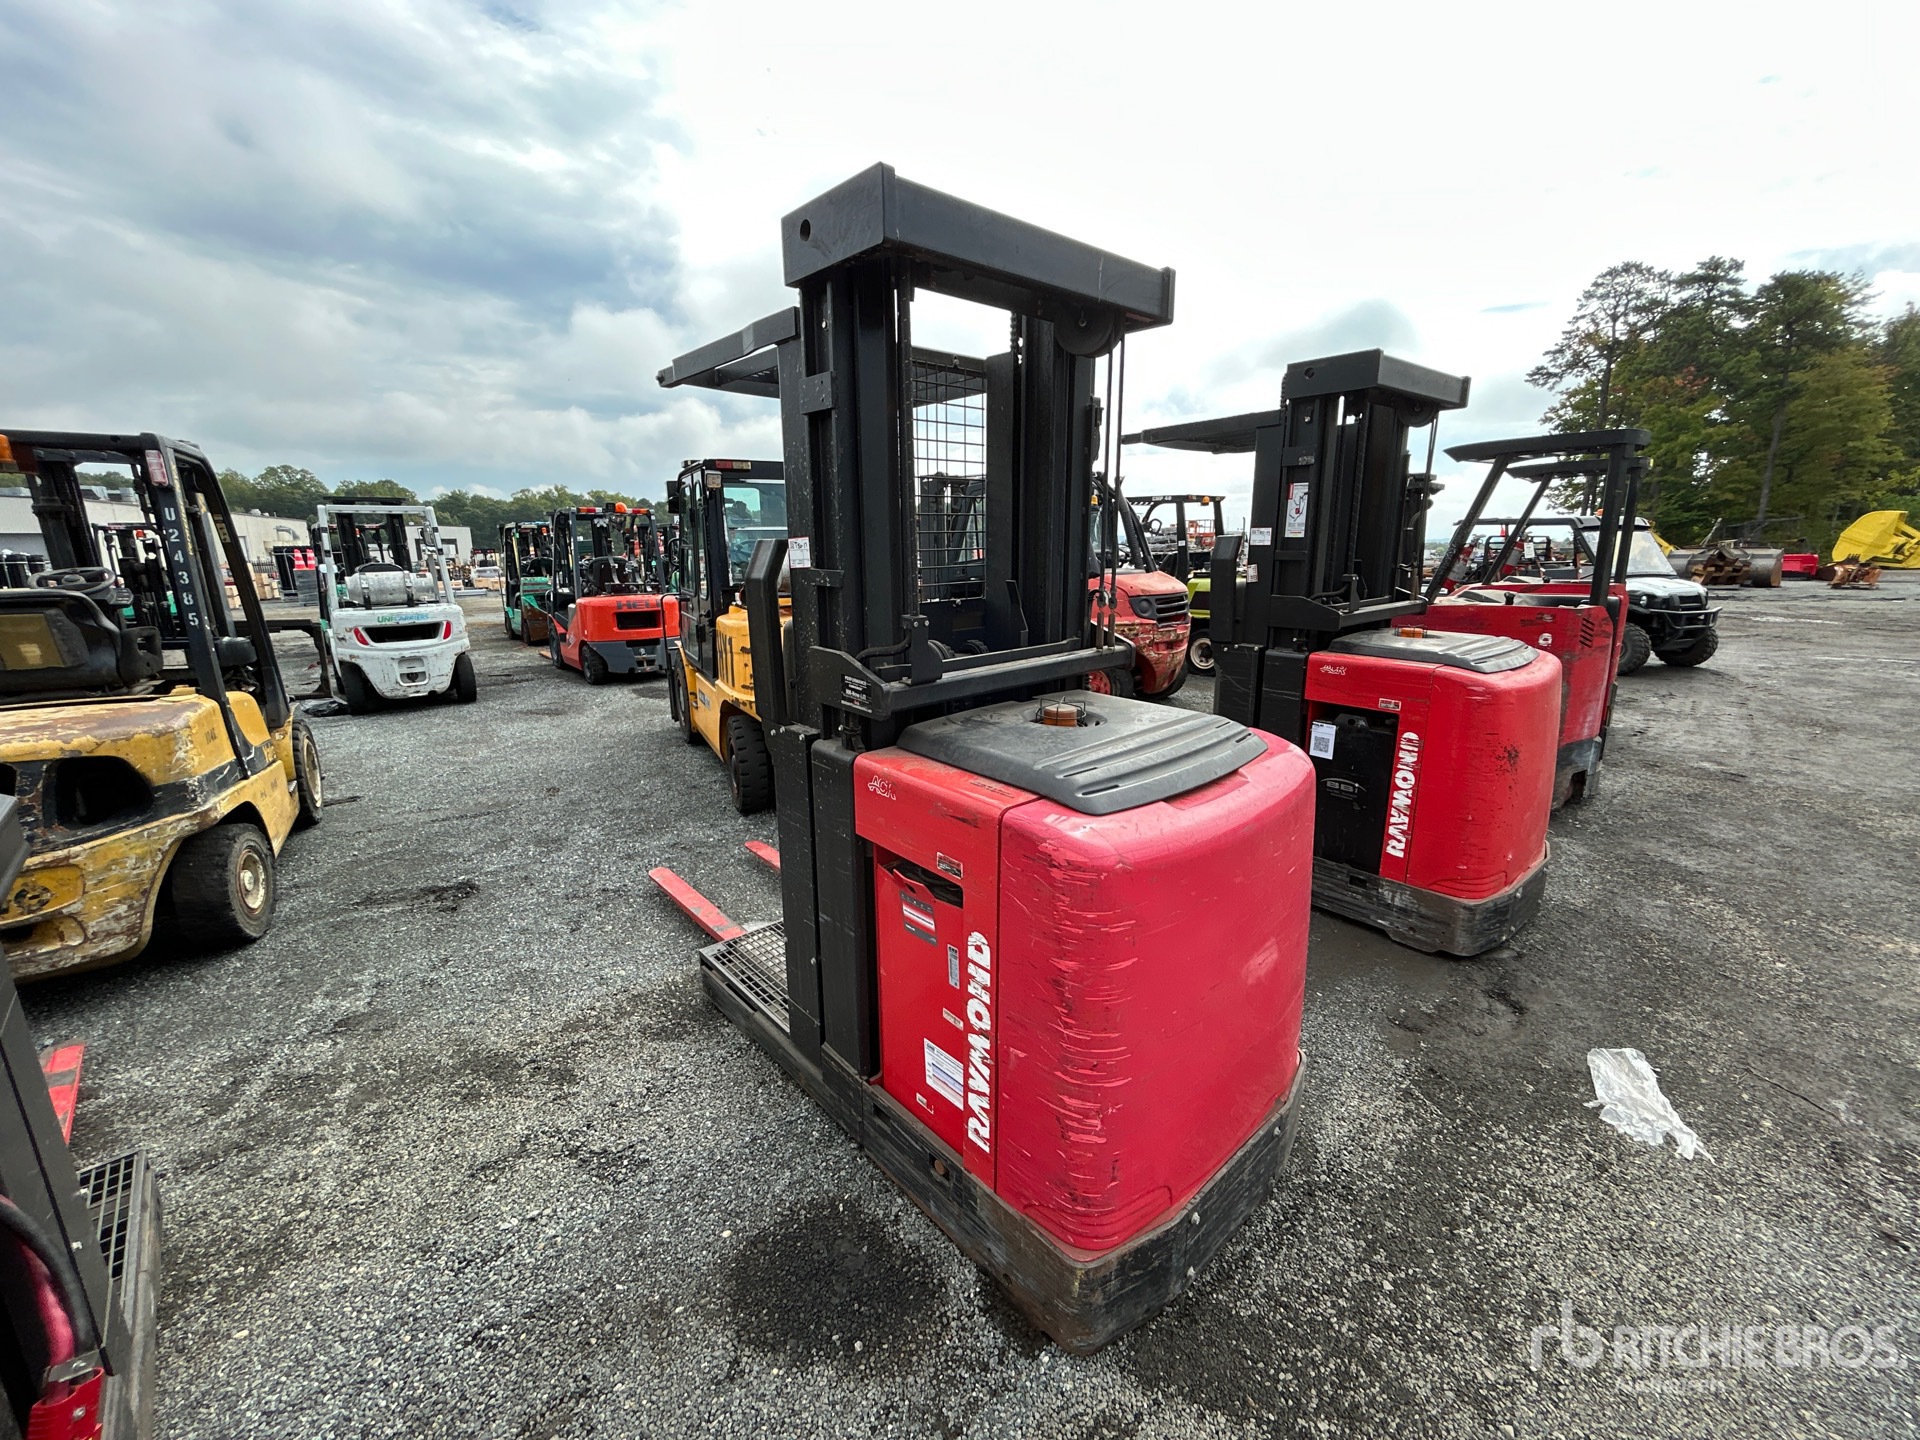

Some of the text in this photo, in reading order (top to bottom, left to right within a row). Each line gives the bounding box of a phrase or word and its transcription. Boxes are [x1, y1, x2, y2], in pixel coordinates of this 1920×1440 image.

[377, 613, 429, 623] UNICARRIERS
[1386, 731, 1419, 858] RAYMOND
[967, 931, 991, 1154] RAYMOND
